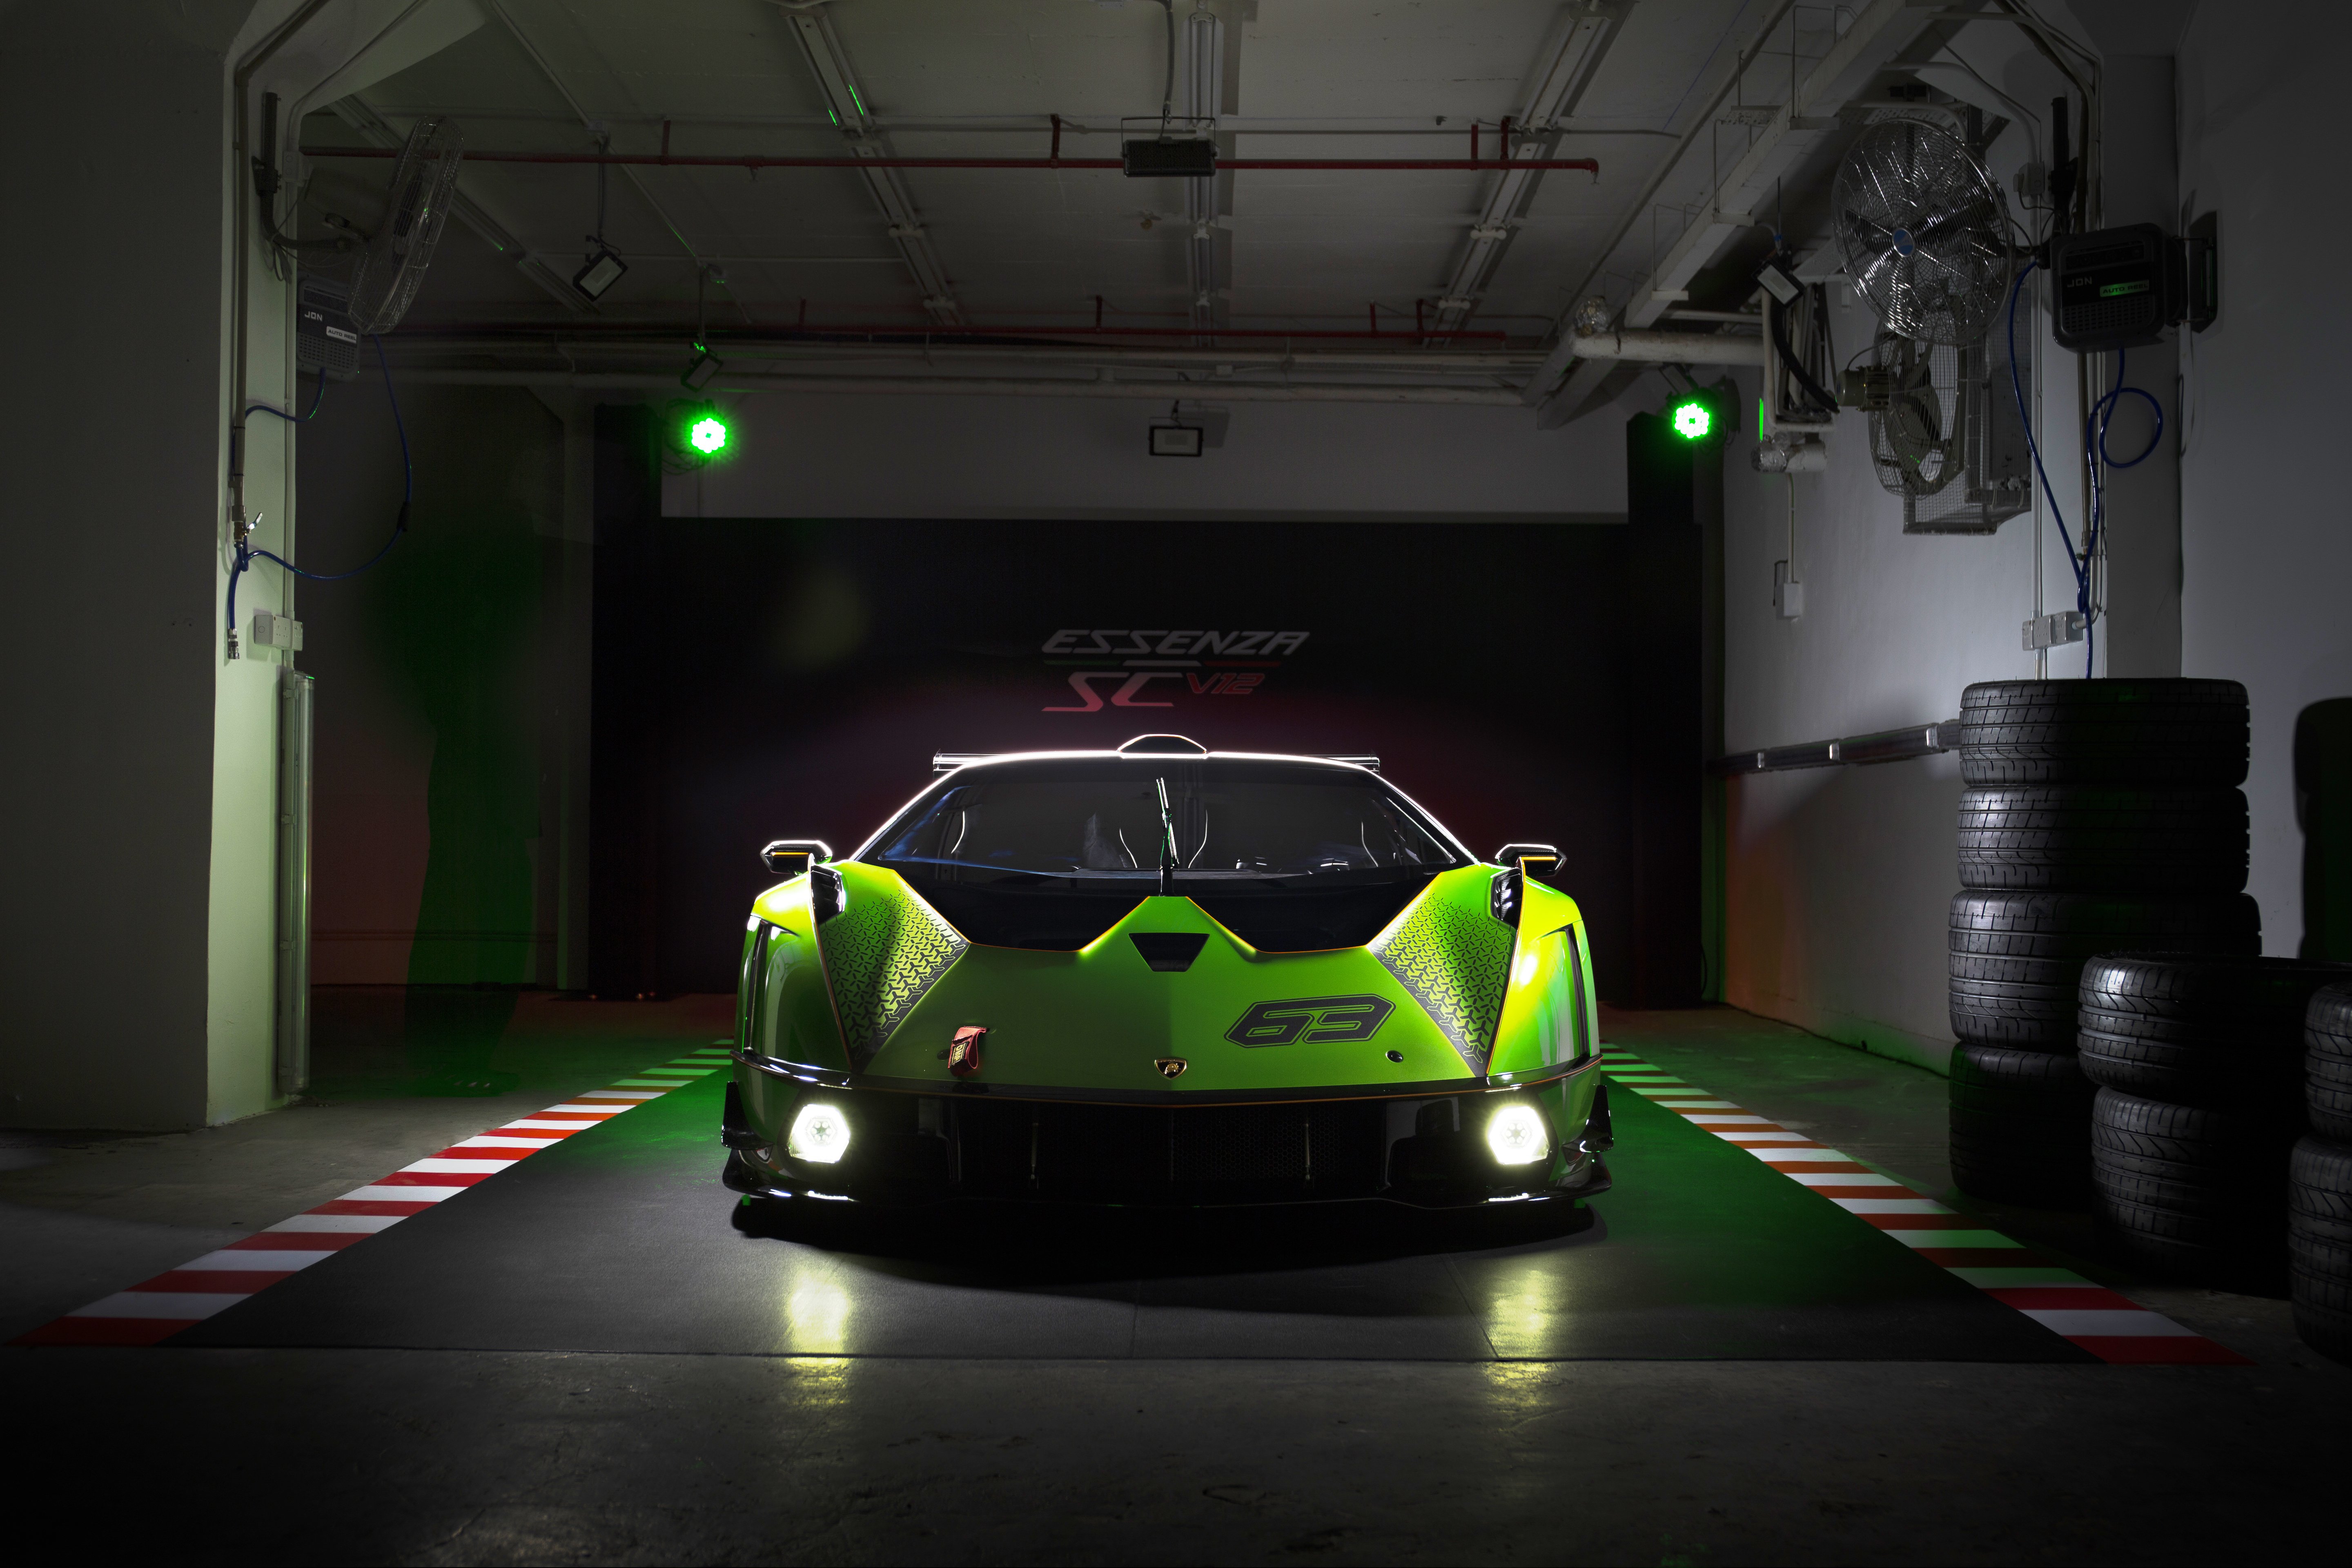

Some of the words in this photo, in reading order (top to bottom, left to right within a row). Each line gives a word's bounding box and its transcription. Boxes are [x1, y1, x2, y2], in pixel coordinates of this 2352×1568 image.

[2067, 276, 2092, 287] JON
[305, 311, 323, 321] JON
[1042, 629, 1310, 655] ESSENZA
[1223, 993, 1396, 1049] 63
[954, 1045, 963, 1061] OMP
